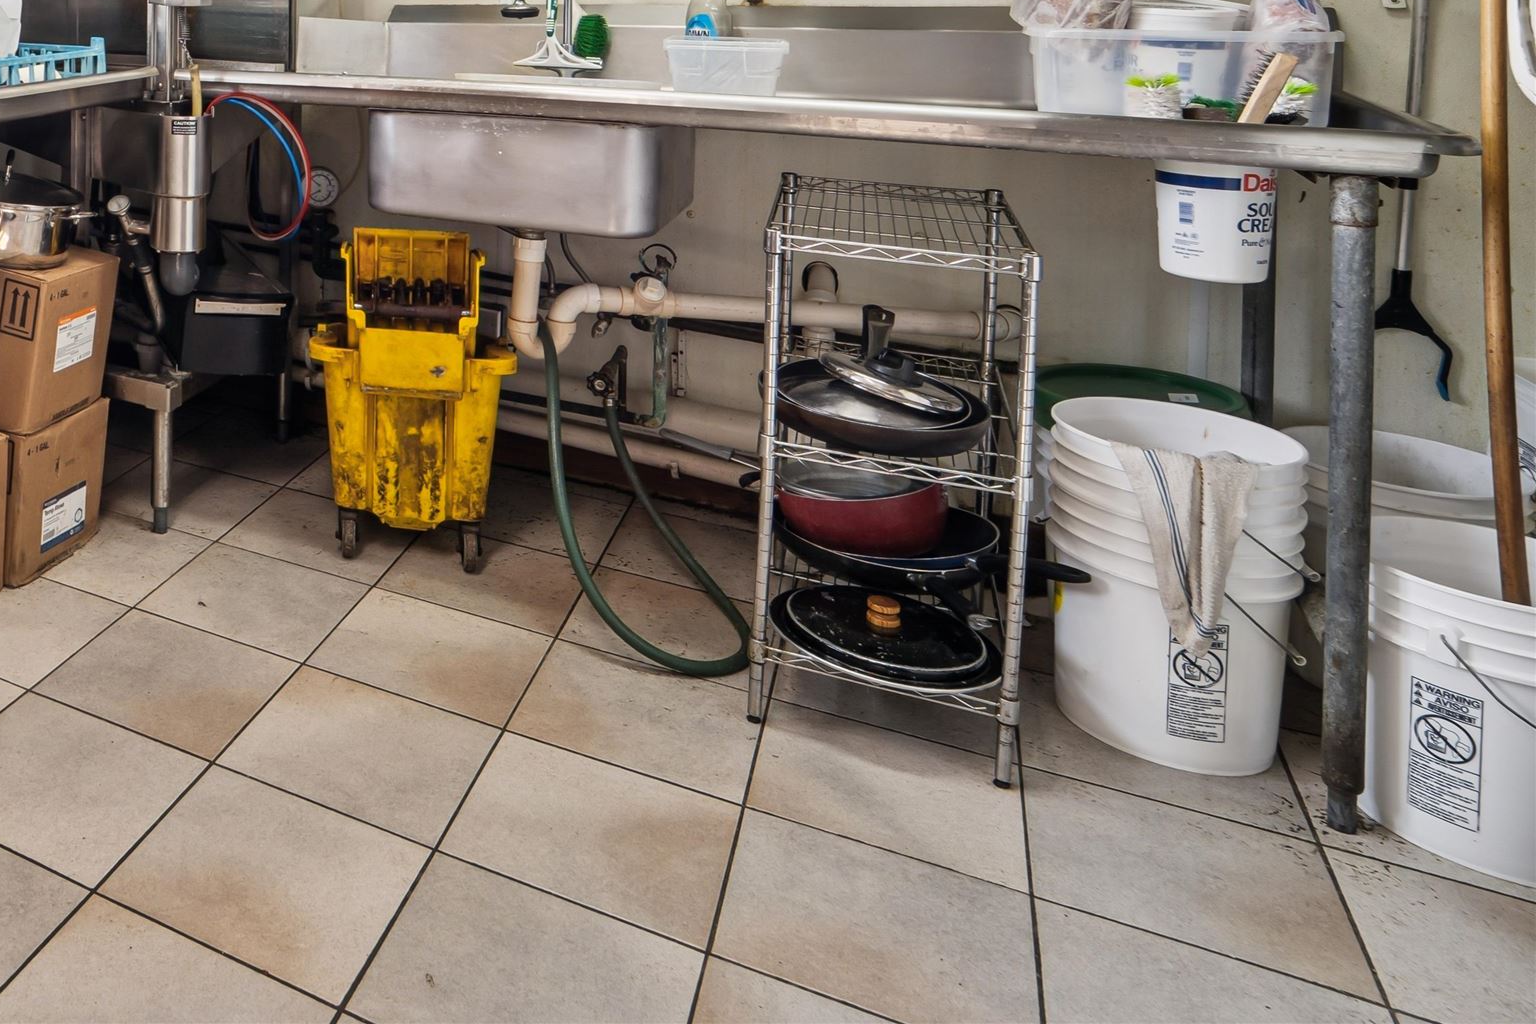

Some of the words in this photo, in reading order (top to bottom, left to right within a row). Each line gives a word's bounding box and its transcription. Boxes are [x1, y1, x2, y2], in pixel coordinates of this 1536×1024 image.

[1244, 173, 1277, 192] Dais
[1247, 203, 1273, 217] SOU
[1237, 219, 1273, 233] CREA
[1241, 239, 1258, 247] Pure
[1425, 684, 1480, 709] WARNING
[1434, 697, 1469, 714] AVISO
